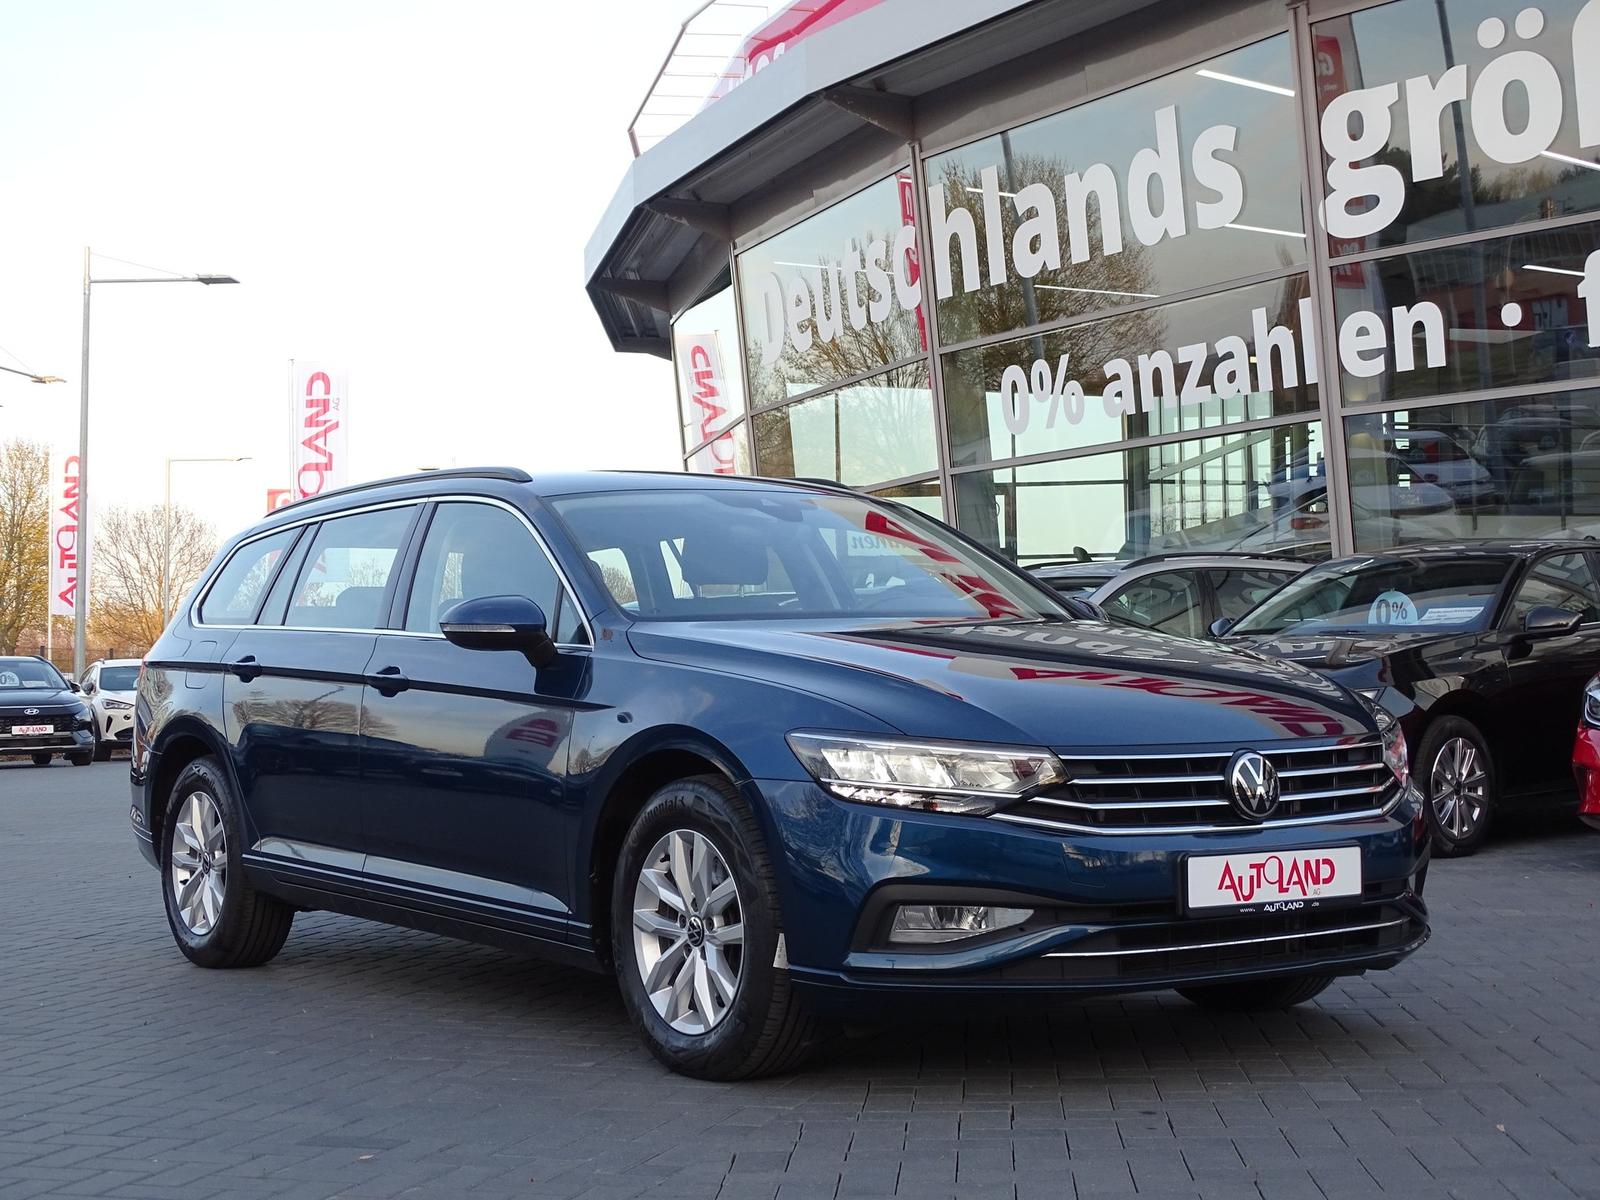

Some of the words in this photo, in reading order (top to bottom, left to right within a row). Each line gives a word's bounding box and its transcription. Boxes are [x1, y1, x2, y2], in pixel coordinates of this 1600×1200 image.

[752, 104, 1245, 364] Deutschlands
[1319, 0, 1600, 239] grö
[1001, 353, 1085, 436] 0%
[1102, 296, 1446, 418] anzahlen
[56, 455, 80, 608] ATOLAND
[1376, 599, 1408, 625] 0%
[1217, 855, 1336, 901] AUTOLAND
